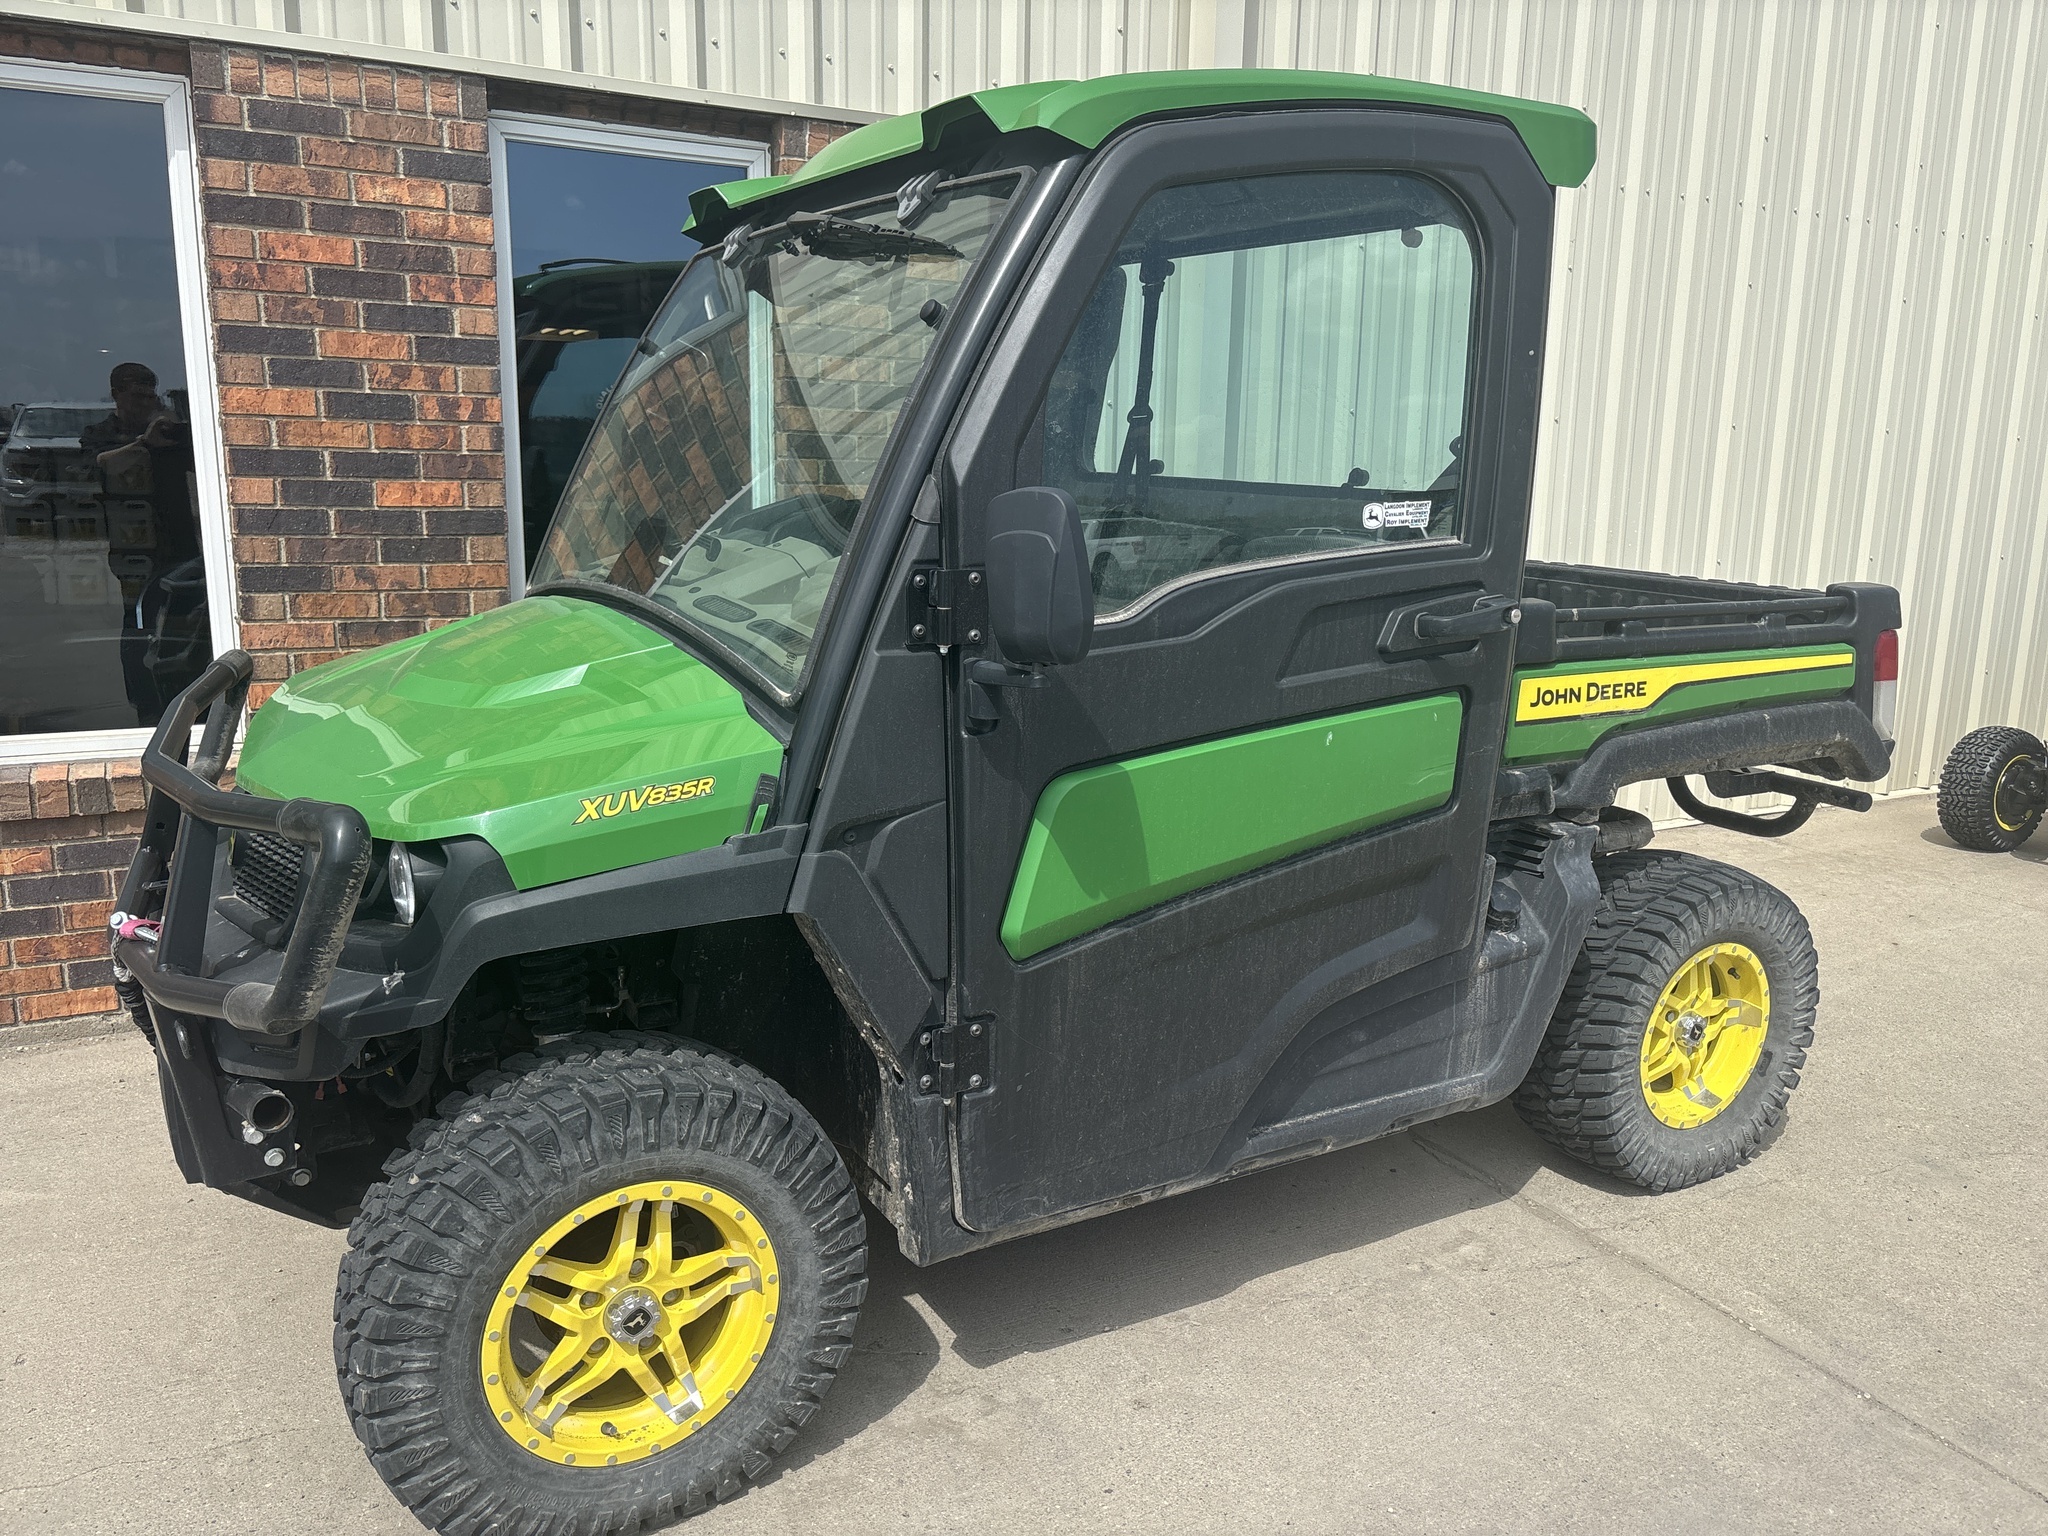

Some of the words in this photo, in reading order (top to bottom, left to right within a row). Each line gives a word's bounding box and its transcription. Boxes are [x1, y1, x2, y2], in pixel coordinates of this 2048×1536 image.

[1530, 687, 1582, 707] JOHN
[1586, 681, 1647, 702] DEERE
[571, 776, 716, 825] XUV835R
